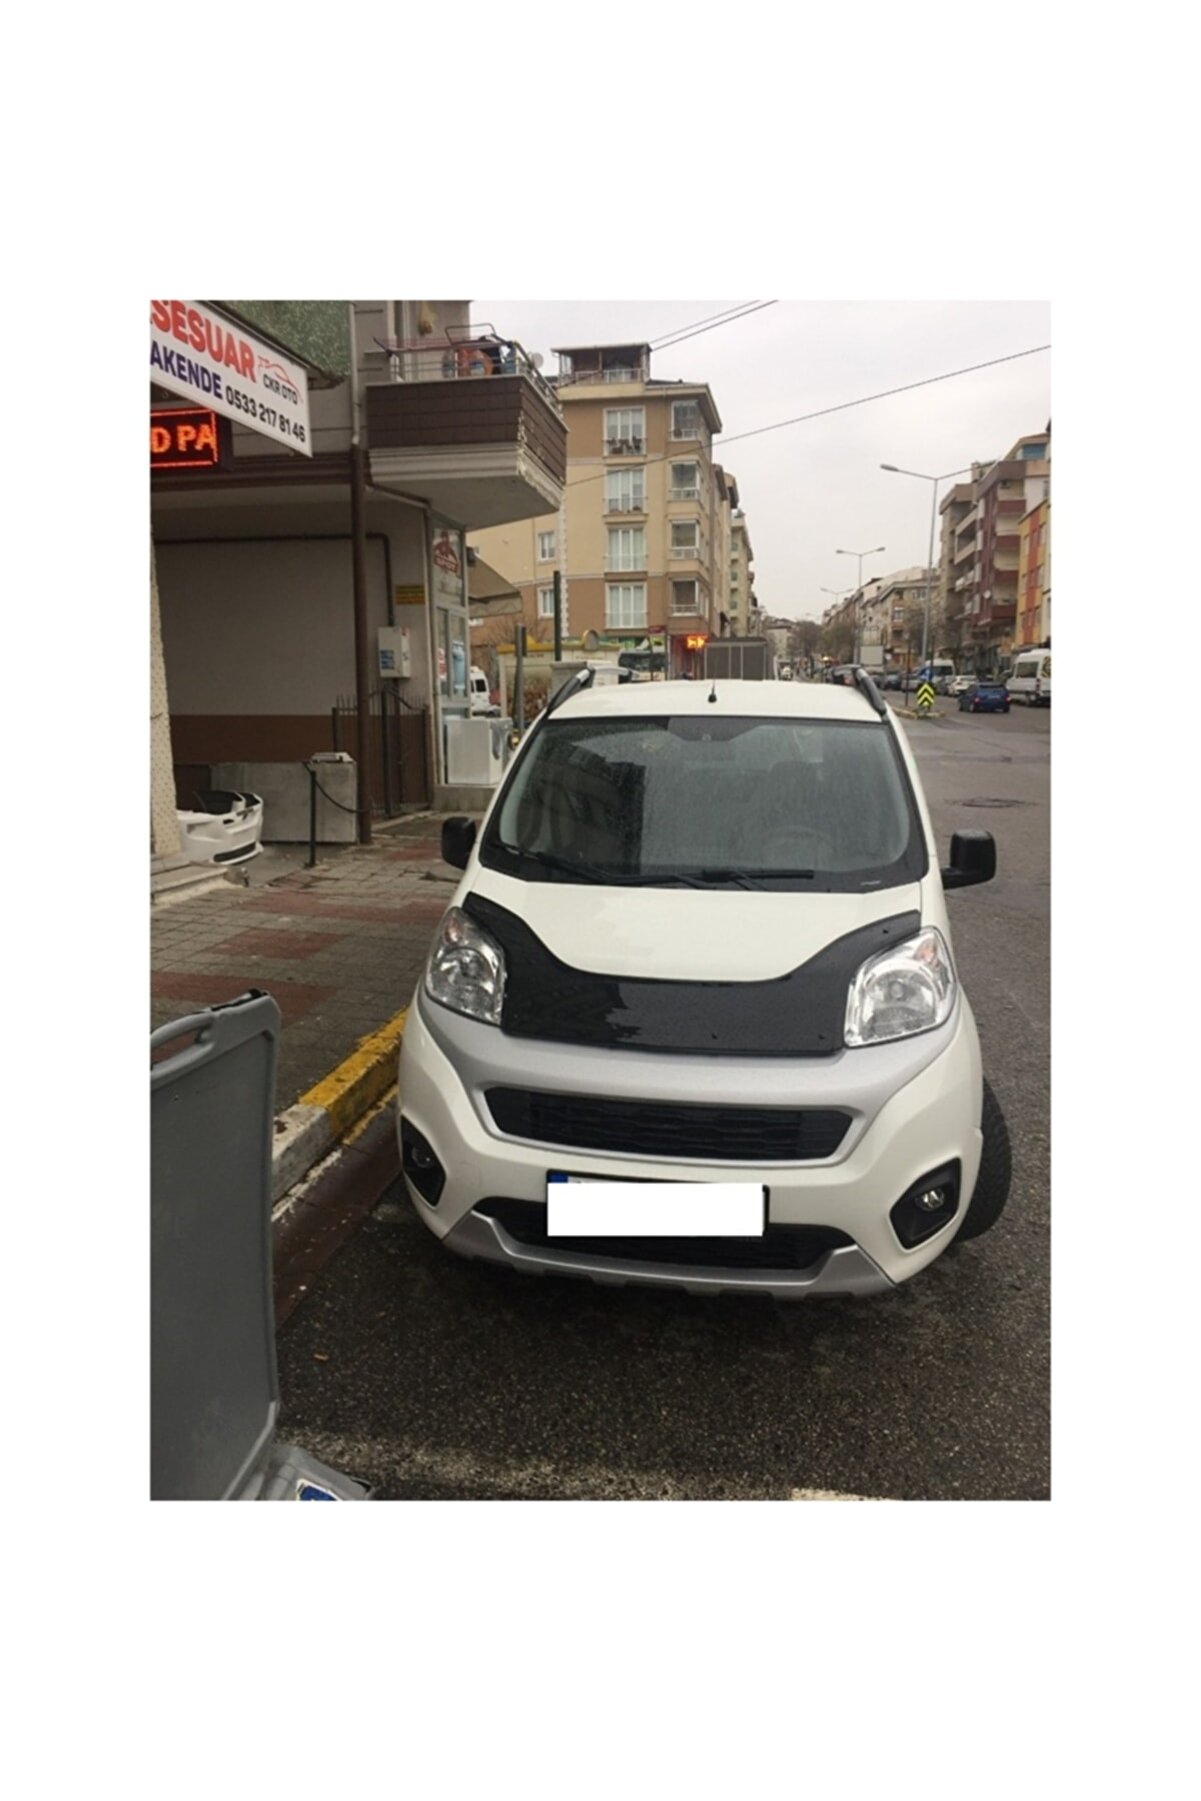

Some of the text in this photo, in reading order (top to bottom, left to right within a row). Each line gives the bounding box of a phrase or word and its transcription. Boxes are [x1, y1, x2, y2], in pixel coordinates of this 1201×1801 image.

[150, 301, 256, 383] SESUAR
[150, 341, 306, 443] AKENDE 0533 217 81 46
[281, 384, 298, 404] OTO
[151, 424, 214, 453] D PA
